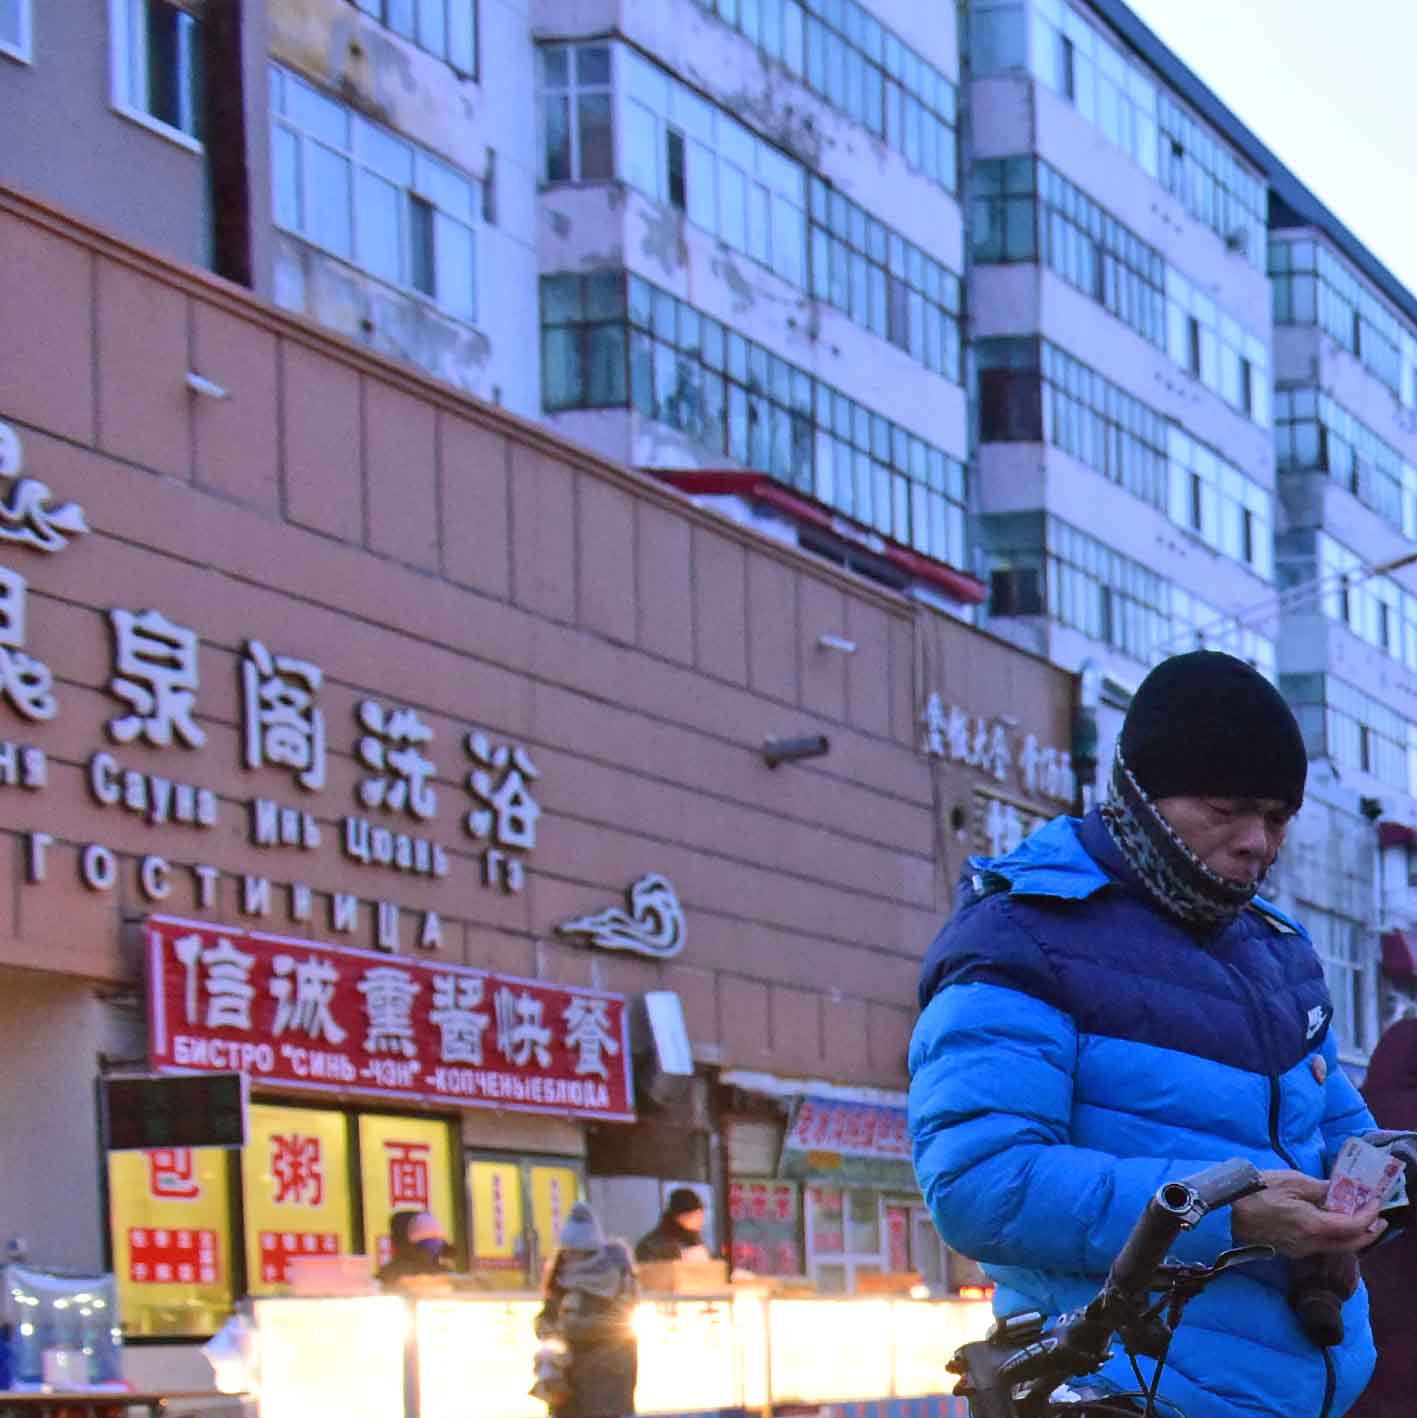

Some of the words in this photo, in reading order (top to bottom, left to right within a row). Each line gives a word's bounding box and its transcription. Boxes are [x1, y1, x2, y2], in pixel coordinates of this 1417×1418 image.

[89, 751, 217, 826] Сауна
[254, 799, 321, 850] Инь
[30, 832, 442, 953] ГОСТИНИЦА
[173, 1034, 275, 1073] БИСТРО
[144, 1148, 201, 1199] 包
[270, 1133, 323, 1206] 粥
[384, 1141, 430, 1208] 面
